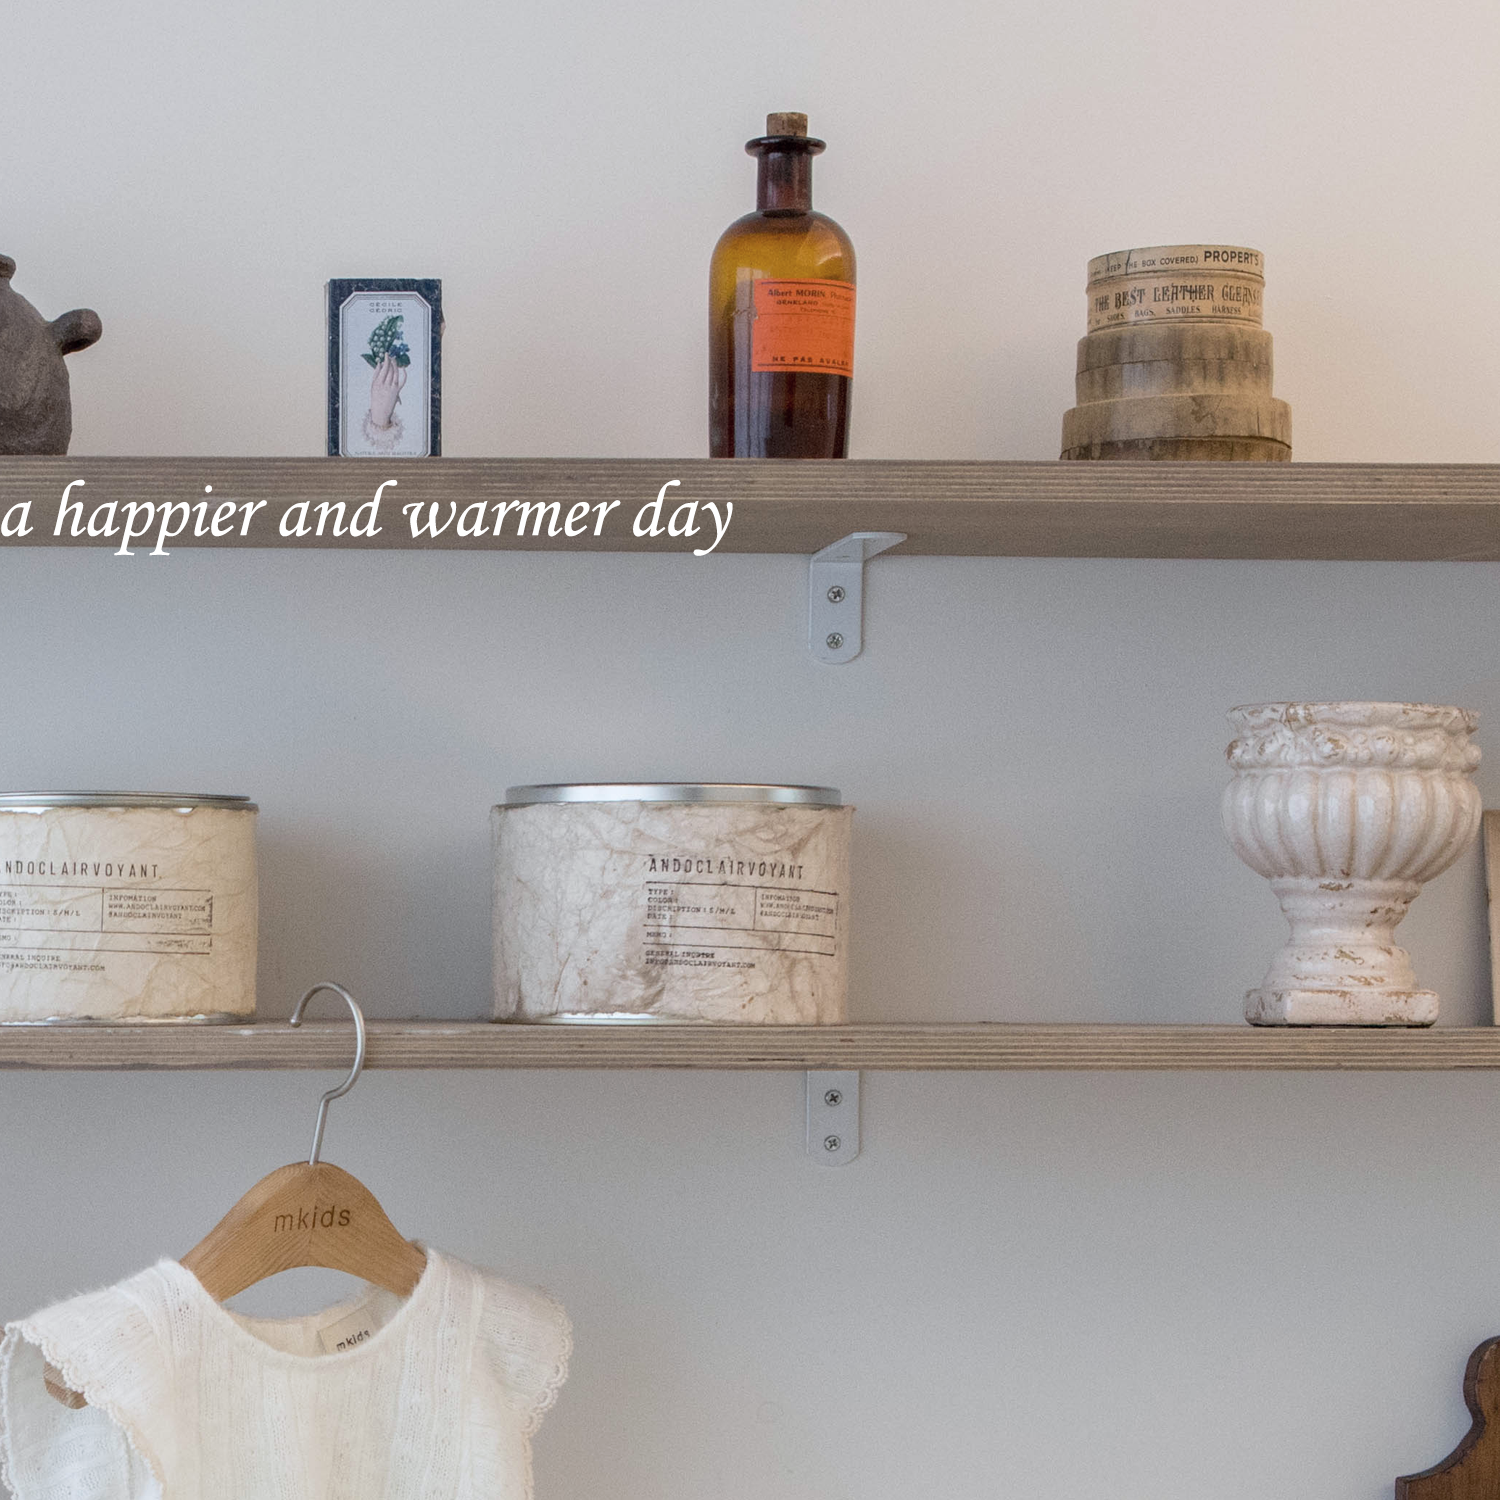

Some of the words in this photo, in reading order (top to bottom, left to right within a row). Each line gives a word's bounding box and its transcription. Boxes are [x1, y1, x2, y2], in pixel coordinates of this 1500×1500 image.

[1141, 259, 1157, 268] BOX
[768, 289, 792, 297] Albert
[795, 289, 826, 298] MORIN
[1114, 286, 1146, 310] BEST
[1153, 283, 1215, 304] LEATHER
[648, 857, 804, 880] ANDOCLAIRVOYANT
[648, 888, 669, 896] TYPE
[647, 896, 673, 904] COLOR
[646, 912, 667, 920] DATE
[274, 1205, 351, 1233] mkids
[336, 1329, 371, 1351] mkids
